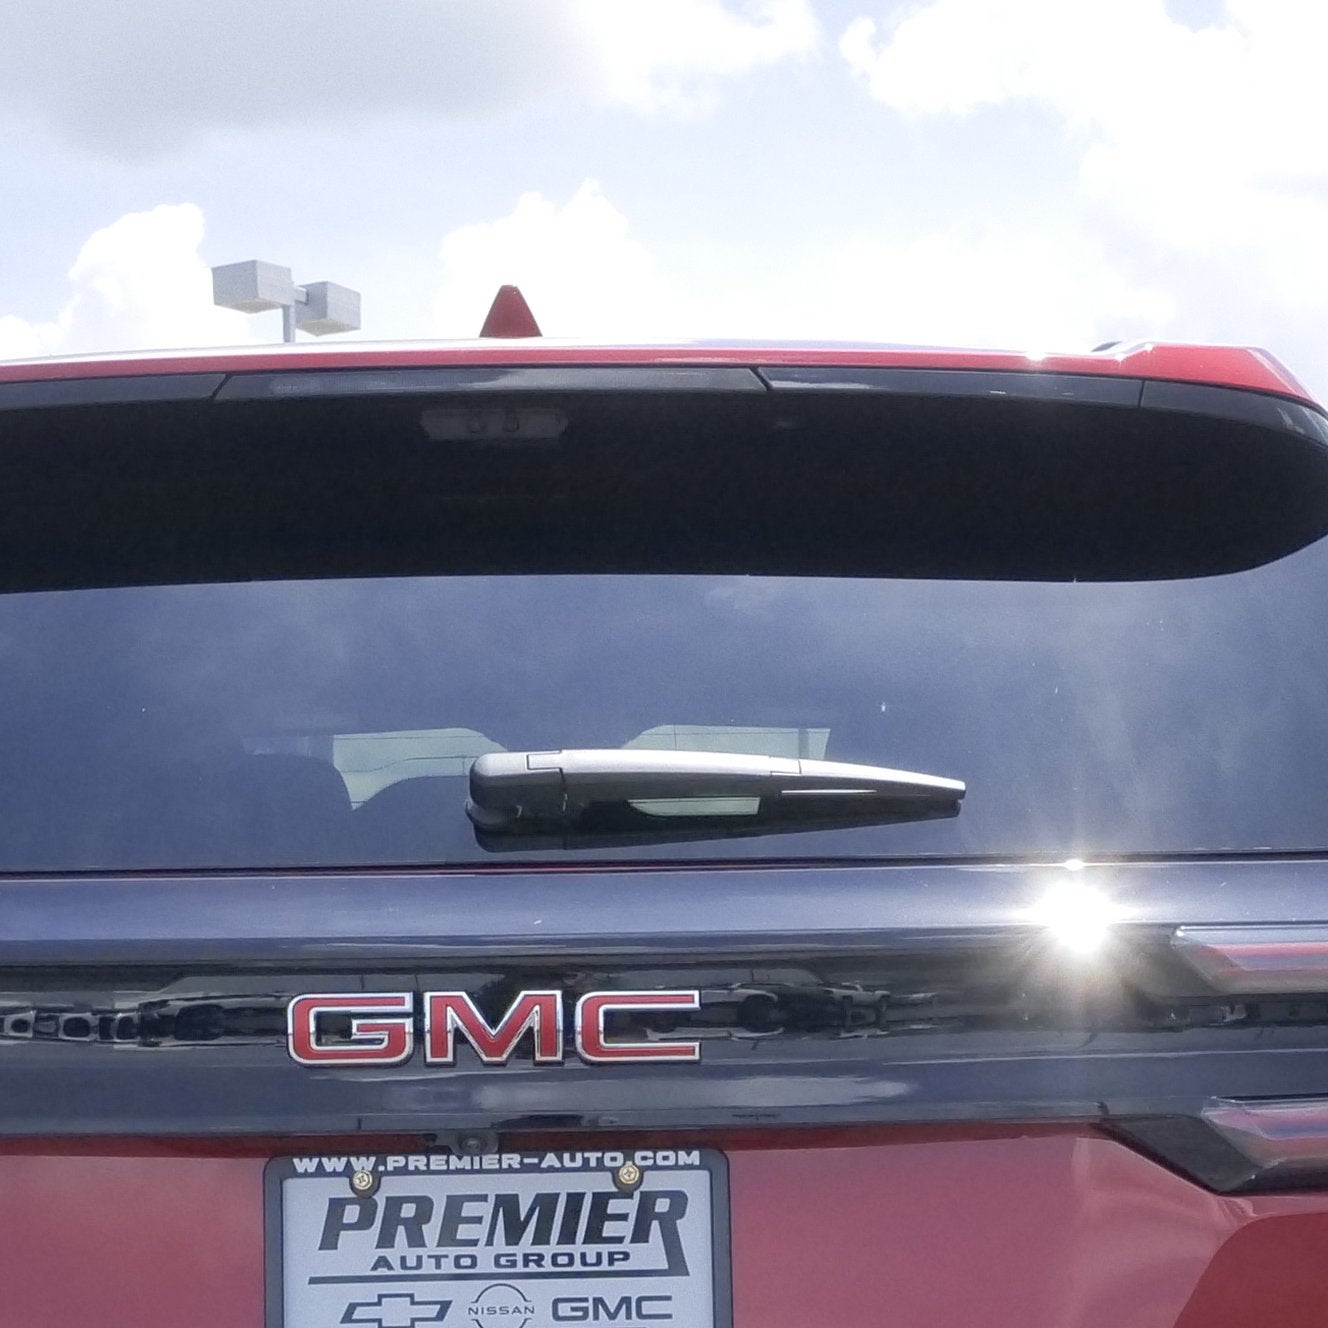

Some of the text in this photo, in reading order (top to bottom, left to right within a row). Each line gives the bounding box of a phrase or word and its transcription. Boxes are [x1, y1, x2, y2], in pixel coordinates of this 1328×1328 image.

[287, 989, 702, 1065] GMC
[292, 1151, 700, 1173] WWW.PREMIER-AUTO.COM
[318, 1190, 690, 1274] PREMIER
[370, 1250, 632, 1272] AUTO GROUP
[467, 1303, 535, 1316] NISSAN
[551, 1295, 673, 1322] GMC
